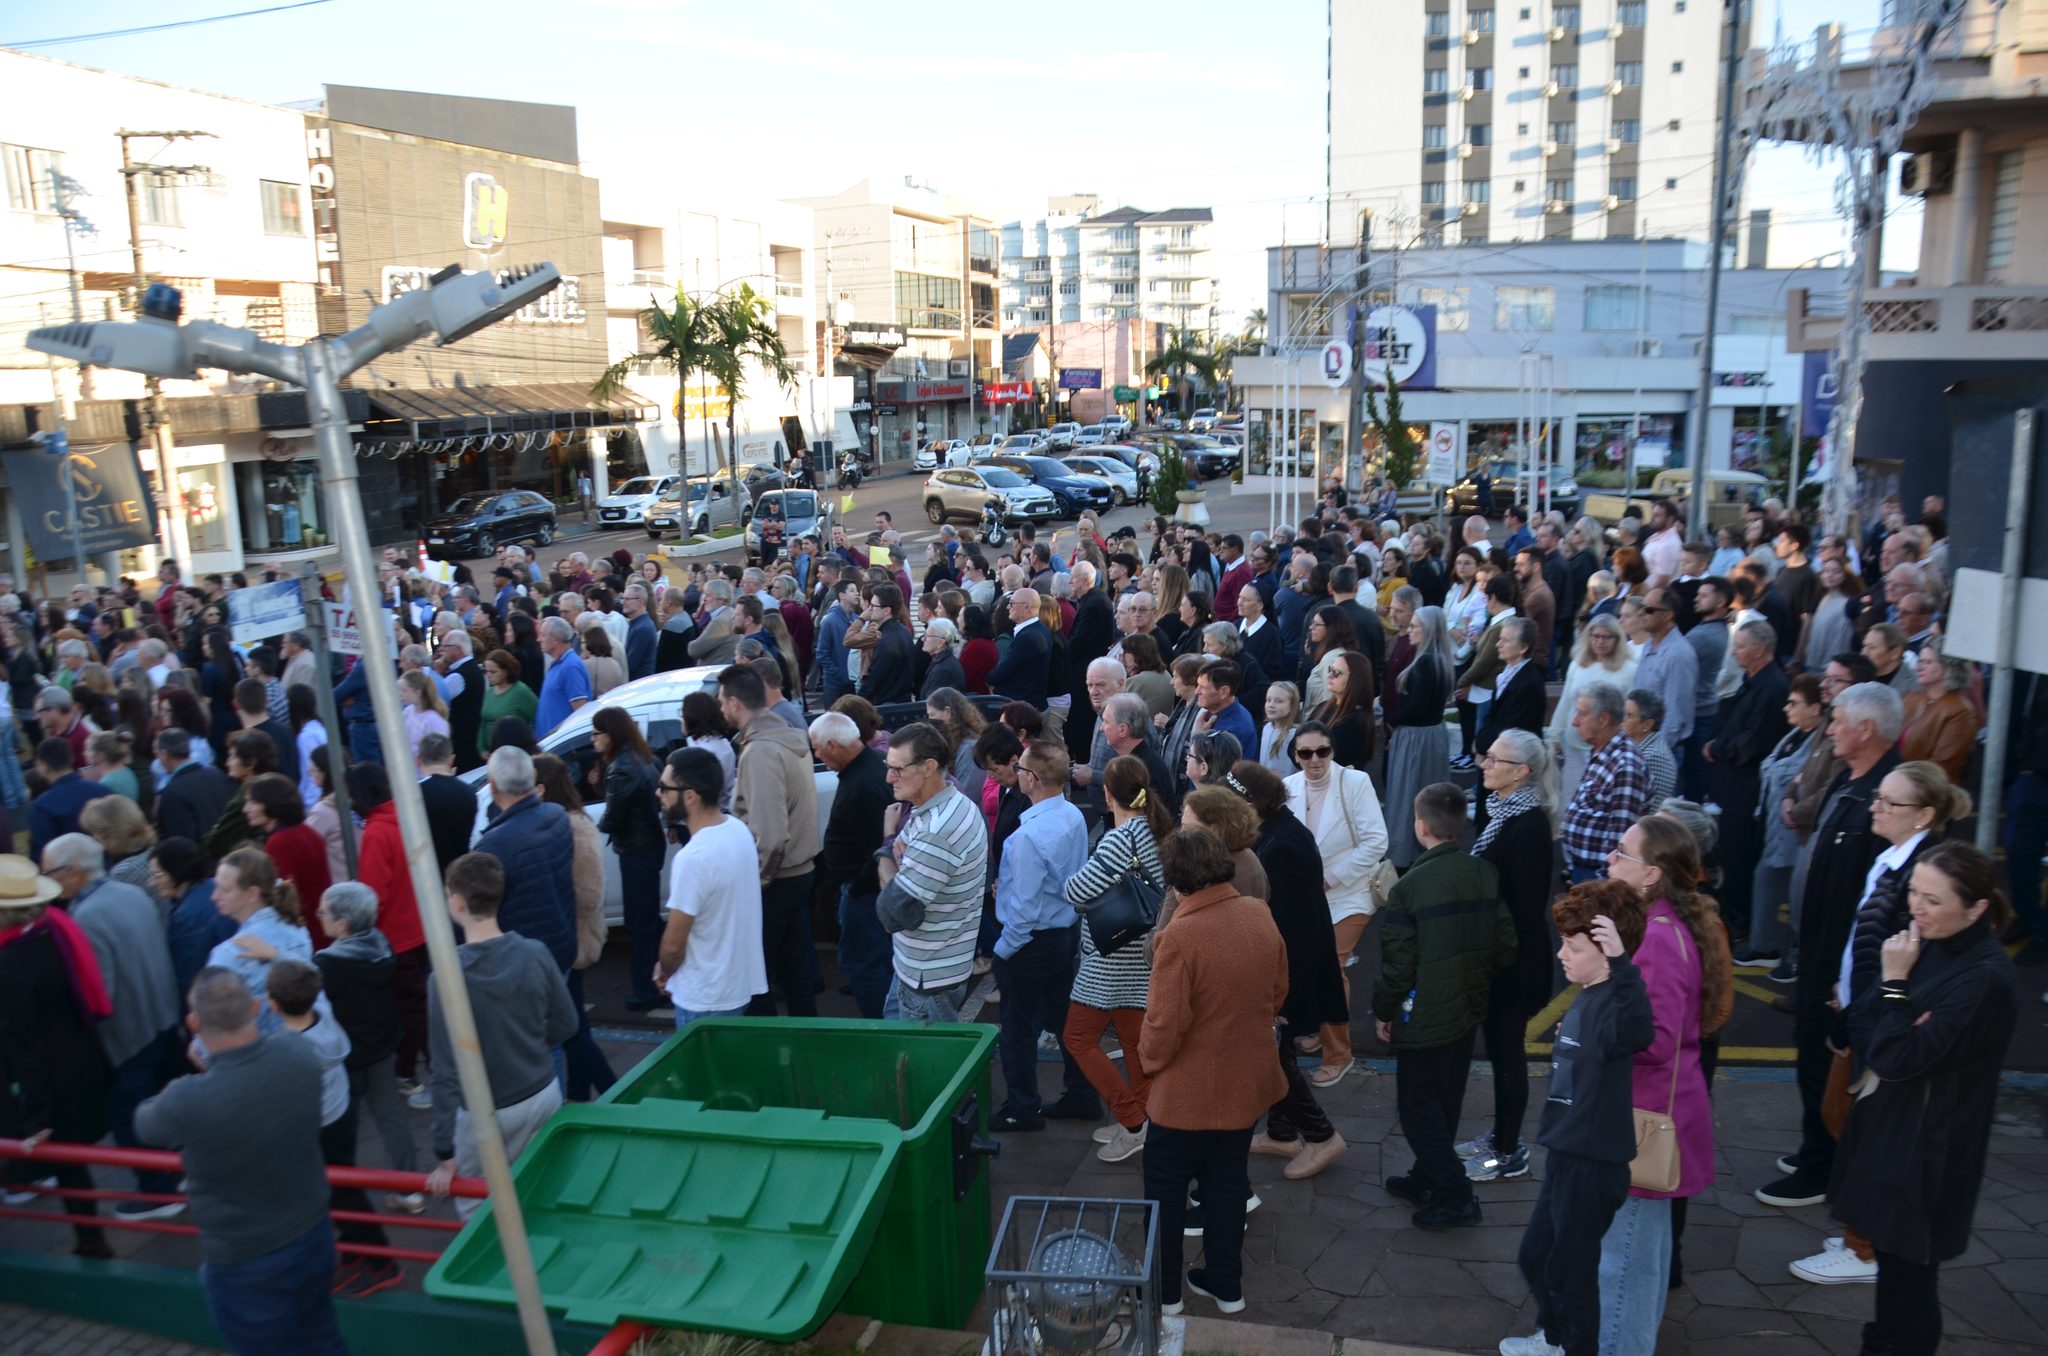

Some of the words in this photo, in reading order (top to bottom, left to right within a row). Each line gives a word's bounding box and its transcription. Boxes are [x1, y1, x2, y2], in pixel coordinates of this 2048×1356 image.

[306, 128, 341, 296] HOTEL
[1365, 342, 1413, 360] BEST
[331, 608, 358, 629] TA
